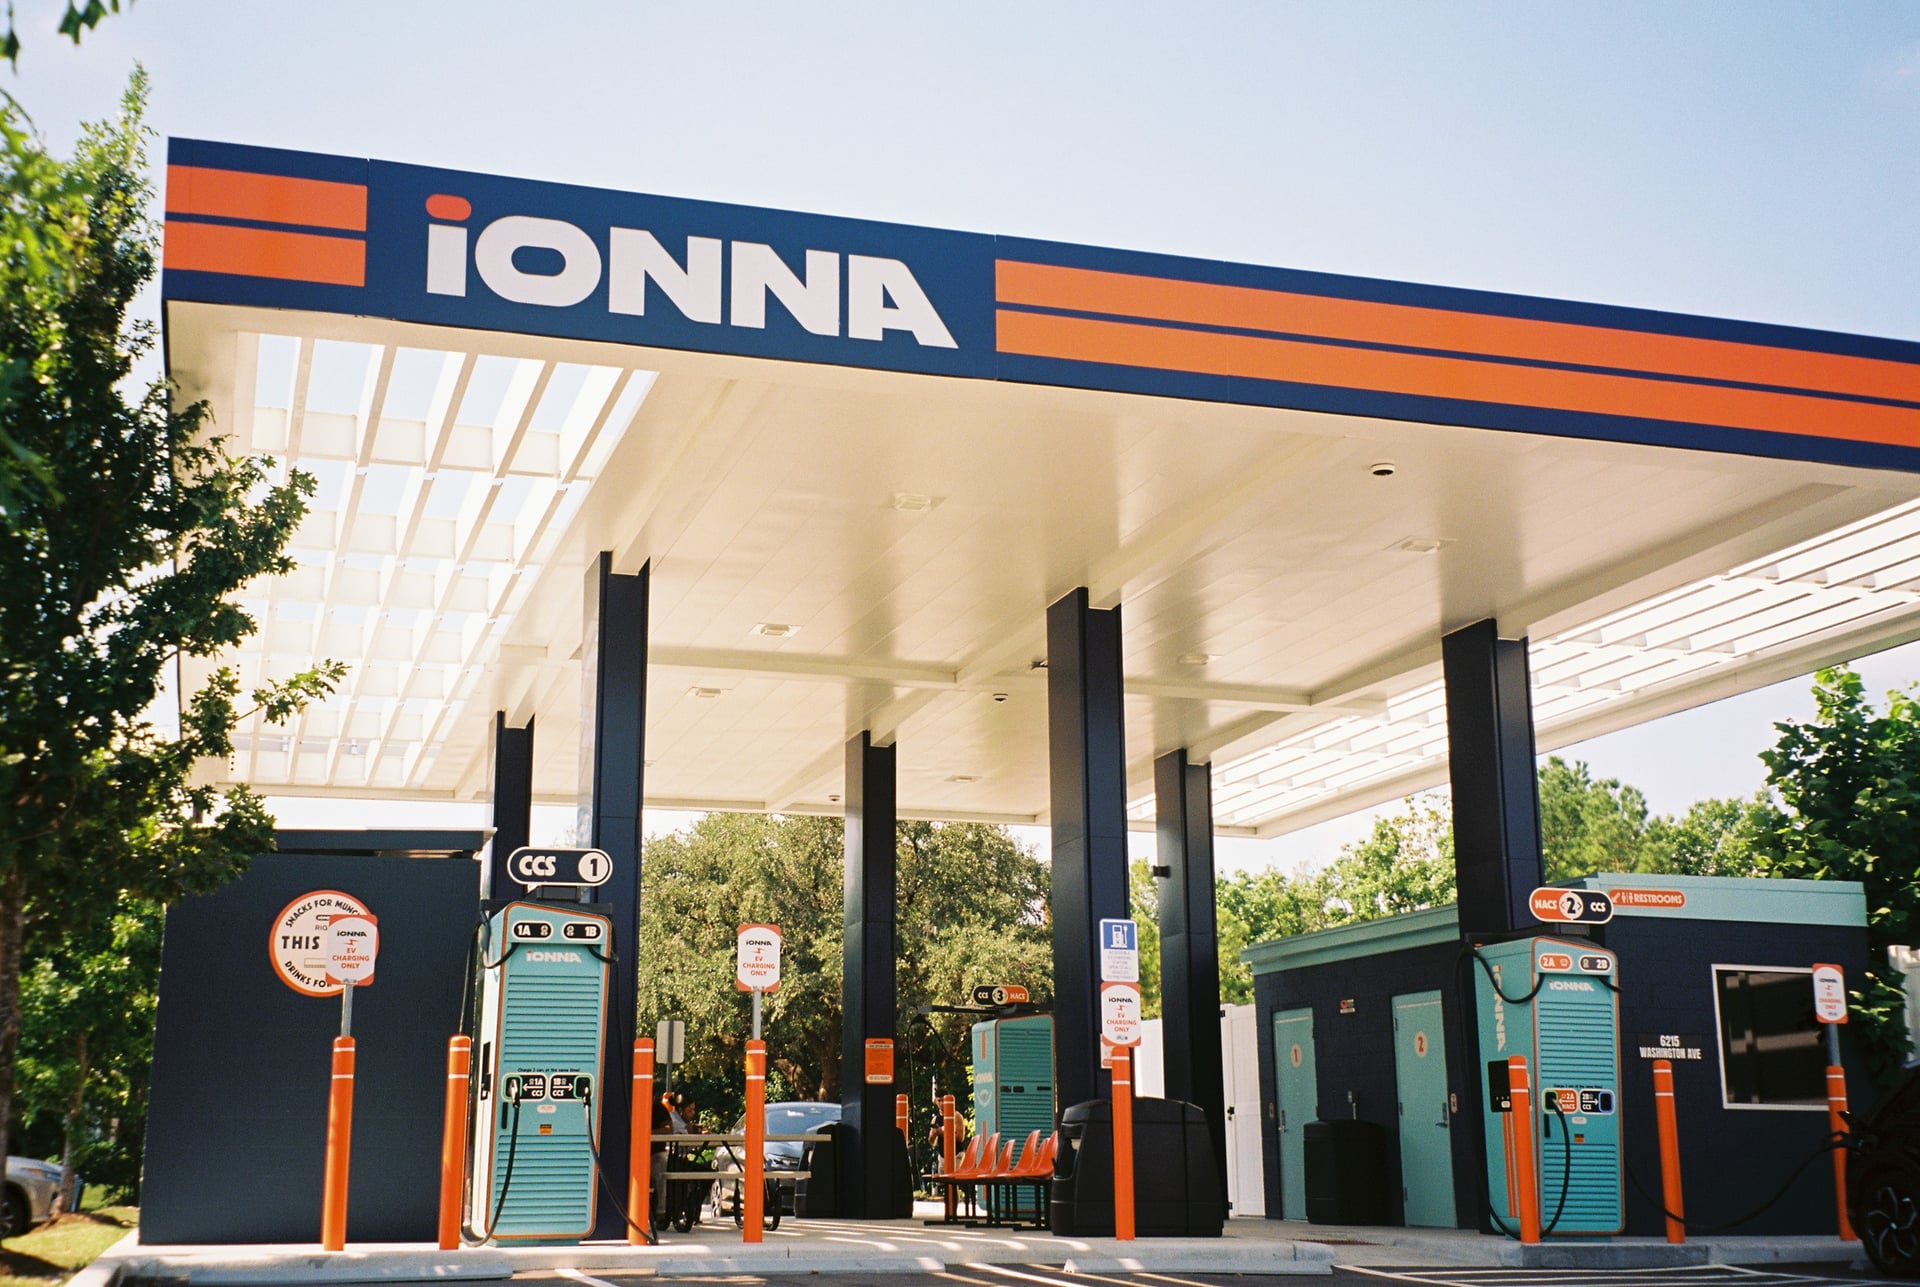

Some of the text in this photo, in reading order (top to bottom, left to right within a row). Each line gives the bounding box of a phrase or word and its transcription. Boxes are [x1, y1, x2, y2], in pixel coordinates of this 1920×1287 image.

[518, 855, 598, 877] CCS 1
[1634, 894, 1682, 904] RESTROOMS
[1566, 897, 1576, 914] 2
[1590, 902, 1606, 912] CCS
[286, 902, 313, 928] SNACKS
[314, 899, 333, 908] FOR
[517, 924, 531, 937] 1A
[585, 926, 597, 937] 1B
[281, 935, 320, 950] THIS
[1543, 957, 1555, 967] 2A
[1596, 959, 1607, 969] 2B
[285, 960, 311, 985] DRINKS
[977, 991, 989, 999] CCS
[997, 990, 1003, 1001] 3
[1418, 1037, 1425, 1053] 2
[1660, 1035, 1680, 1047] 6215
[1639, 1047, 1702, 1060] WASHINGTON AVE
[531, 1089, 544, 1097] CCS
[552, 1089, 565, 1097] CCS
